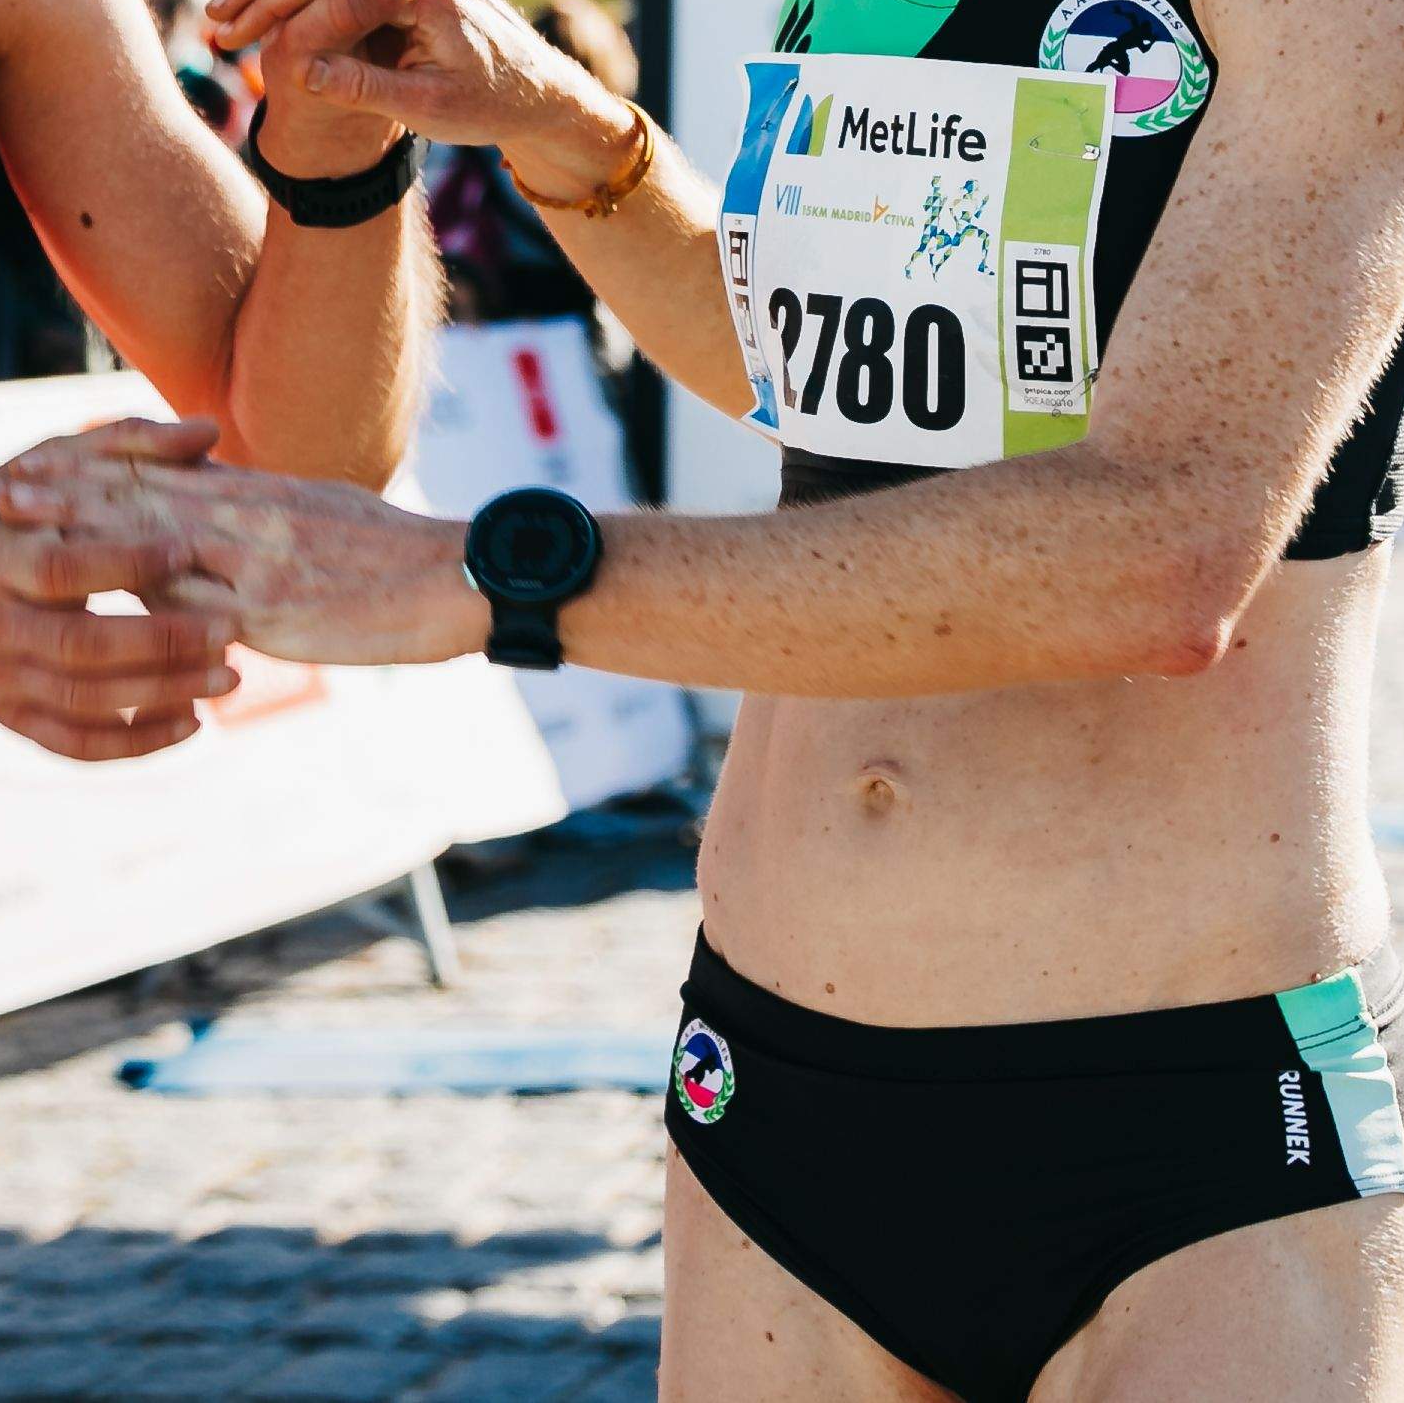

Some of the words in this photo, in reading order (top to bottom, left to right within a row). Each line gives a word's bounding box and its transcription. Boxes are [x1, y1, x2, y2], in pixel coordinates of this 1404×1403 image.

[838, 106, 987, 162] MetLife
[775, 183, 803, 216] VIII
[801, 206, 828, 219] 15KM
[831, 207, 871, 223] MADRID
[769, 287, 966, 432] 2780
[1278, 1070, 1310, 1165] RUNNEK
